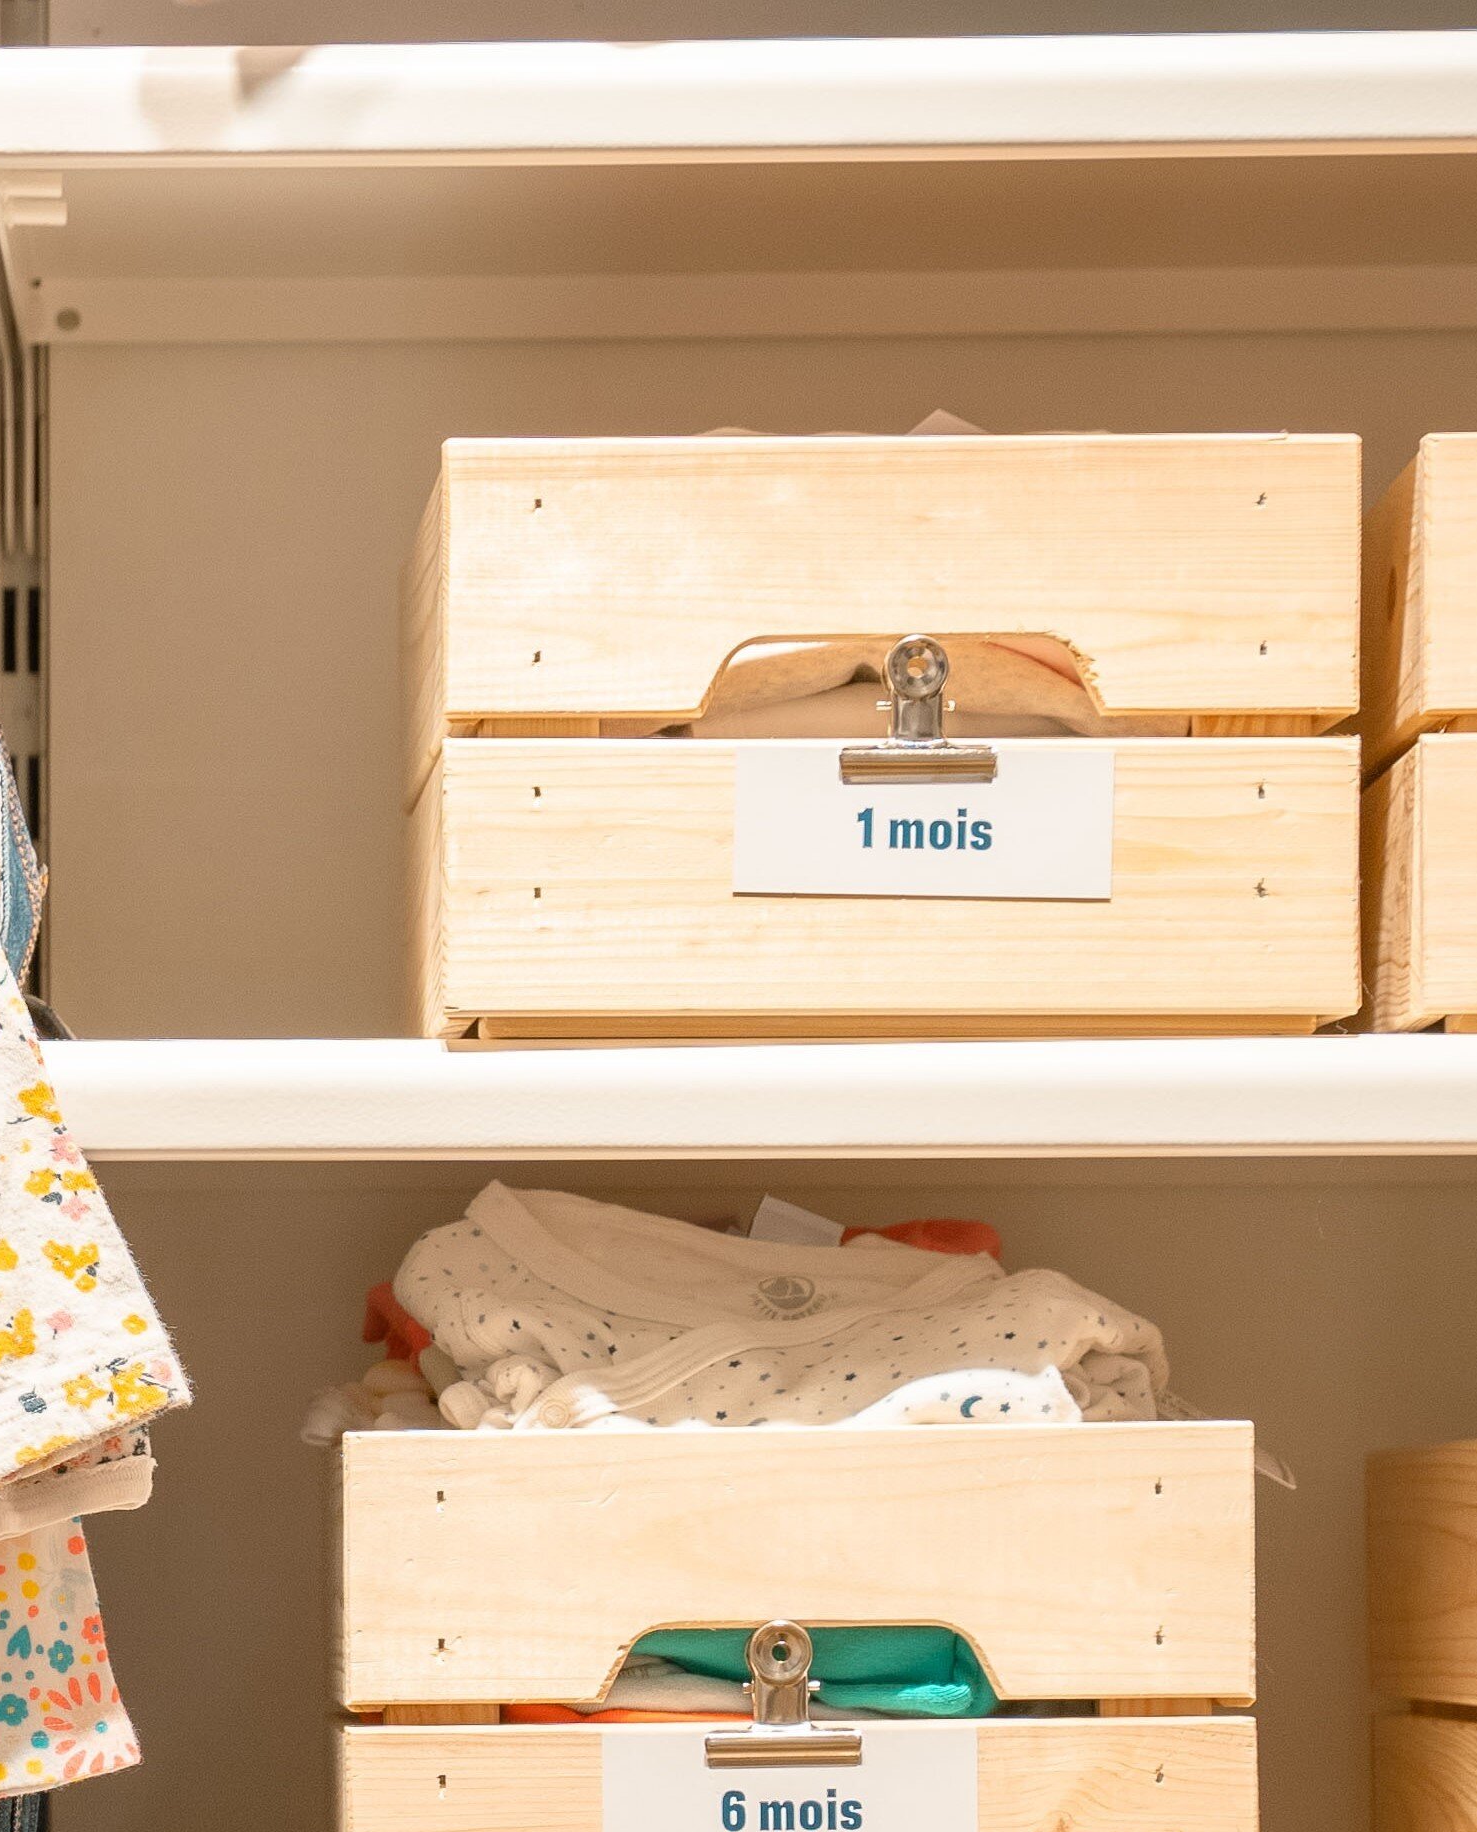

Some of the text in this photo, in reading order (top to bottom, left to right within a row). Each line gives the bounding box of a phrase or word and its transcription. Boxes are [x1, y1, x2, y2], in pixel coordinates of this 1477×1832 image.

[857, 807, 993, 851] 1 mois
[721, 1788, 863, 1832] 6 mois
